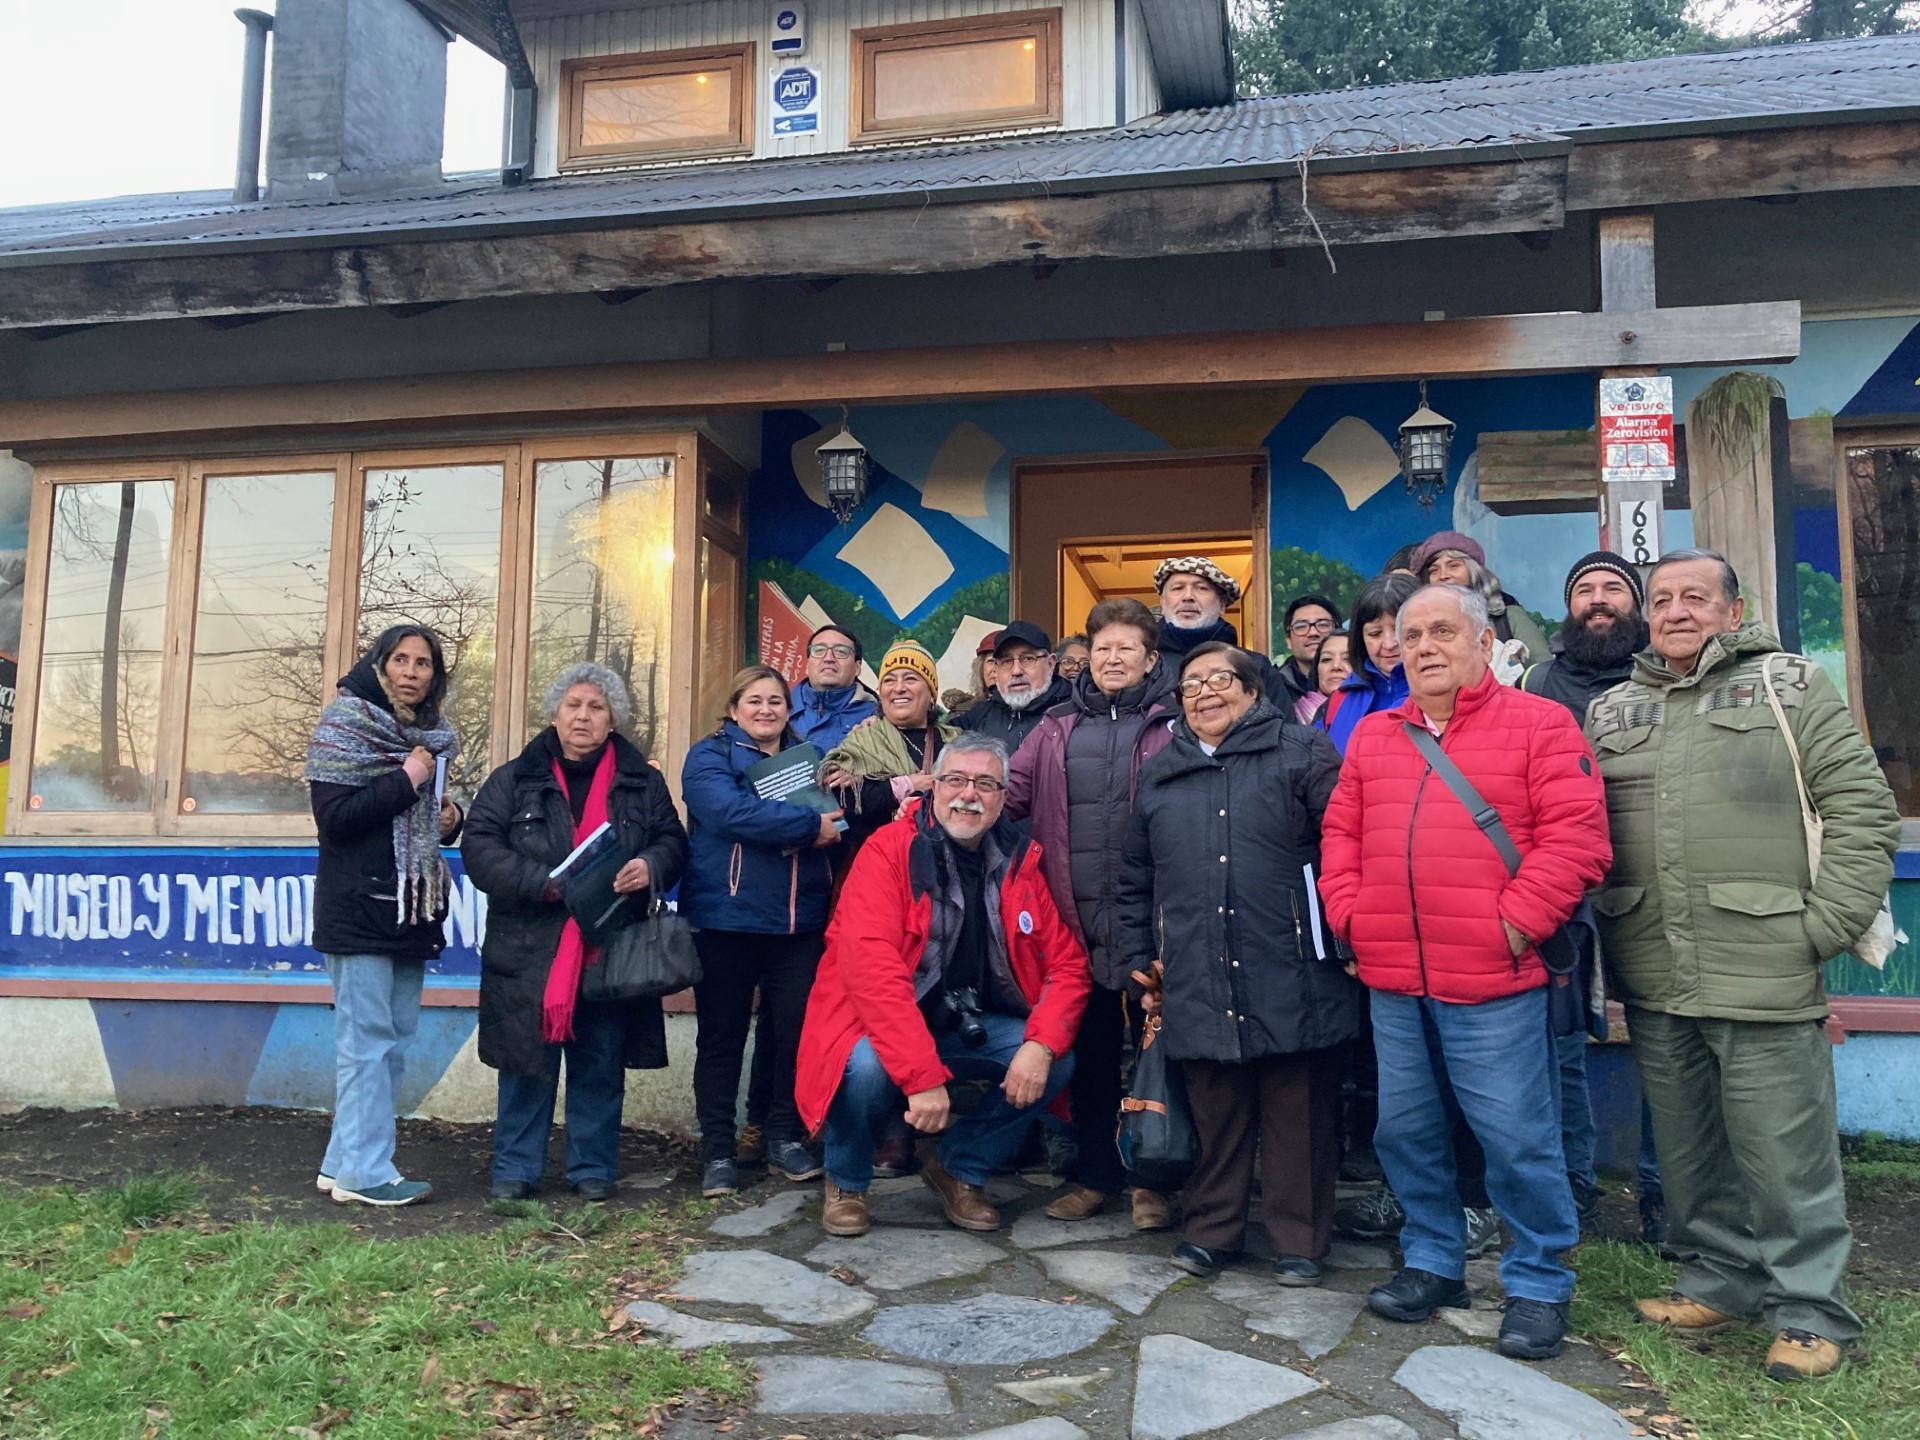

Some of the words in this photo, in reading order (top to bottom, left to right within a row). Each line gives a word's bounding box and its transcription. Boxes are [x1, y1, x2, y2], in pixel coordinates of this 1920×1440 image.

[780, 16, 794, 25] ADT
[781, 80, 810, 98] ADT
[1609, 402, 1664, 411] verisure
[1616, 416, 1658, 427] Alarma
[1606, 426, 1669, 438] Zerovision
[1632, 501, 1650, 563] 660
[761, 616, 774, 665] MUJERES
[773, 641, 785, 654] LA
[5, 871, 132, 941] MUSEO
